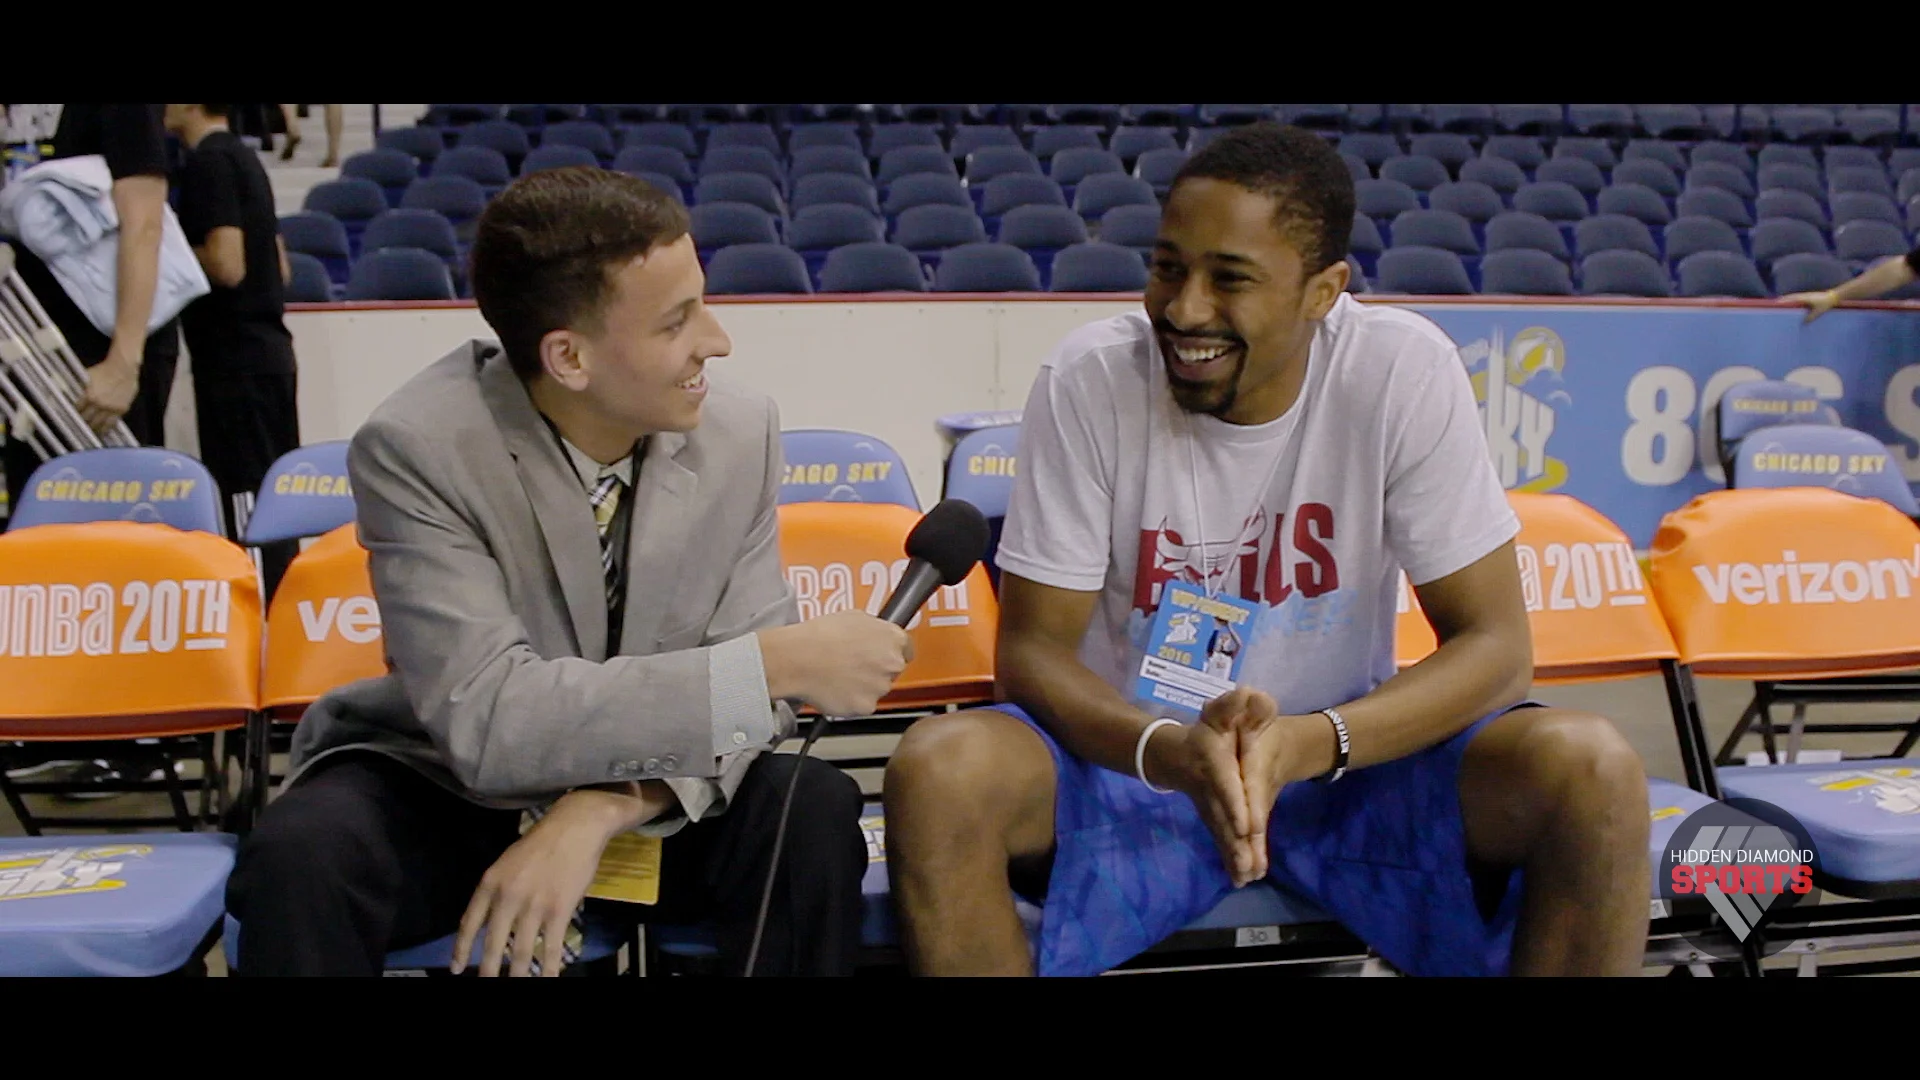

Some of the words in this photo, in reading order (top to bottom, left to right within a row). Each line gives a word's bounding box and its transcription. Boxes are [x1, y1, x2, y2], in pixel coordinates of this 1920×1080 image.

[1478, 326, 1555, 490] KY
[847, 461, 892, 484] SKY
[1753, 452, 1841, 475] CHICAGO
[1847, 454, 1887, 475] SKY
[36, 478, 143, 503] CHICAGO
[148, 478, 197, 501] SKY
[274, 473, 354, 498] CHICA
[1132, 502, 1340, 617] BLLS
[1691, 549, 1912, 606] verizon
[119, 579, 231, 654] 20TH
